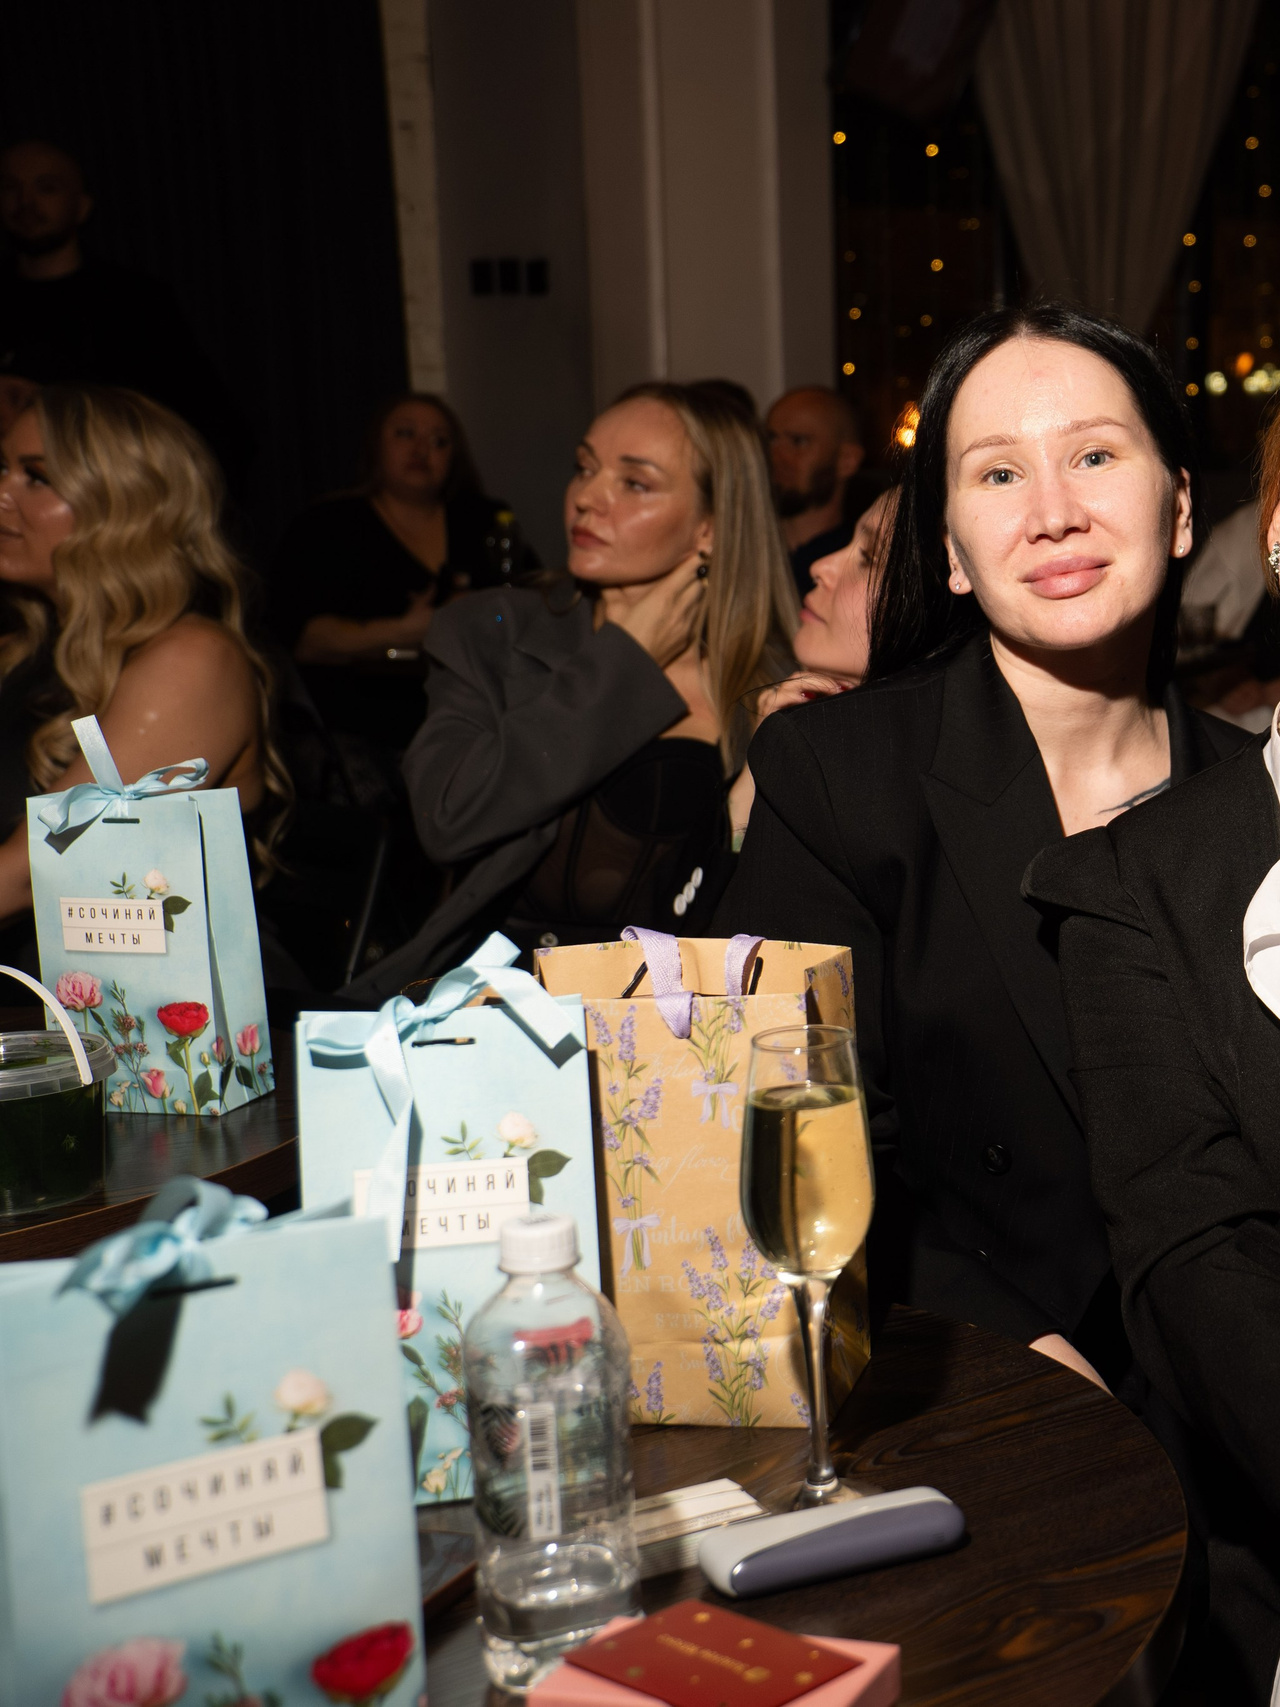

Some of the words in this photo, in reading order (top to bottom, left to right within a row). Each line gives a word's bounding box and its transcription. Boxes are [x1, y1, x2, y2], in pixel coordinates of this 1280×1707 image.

[67, 906, 156, 920] #СОЧИНЯЙ
[85, 931, 141, 945] МЕЧТЫ
[406, 1168, 516, 1198] ОЧИНЯЙ
[101, 1447, 306, 1527] #СОЧИНЯЙ
[143, 1512, 275, 1571] МЕЧТЫ
